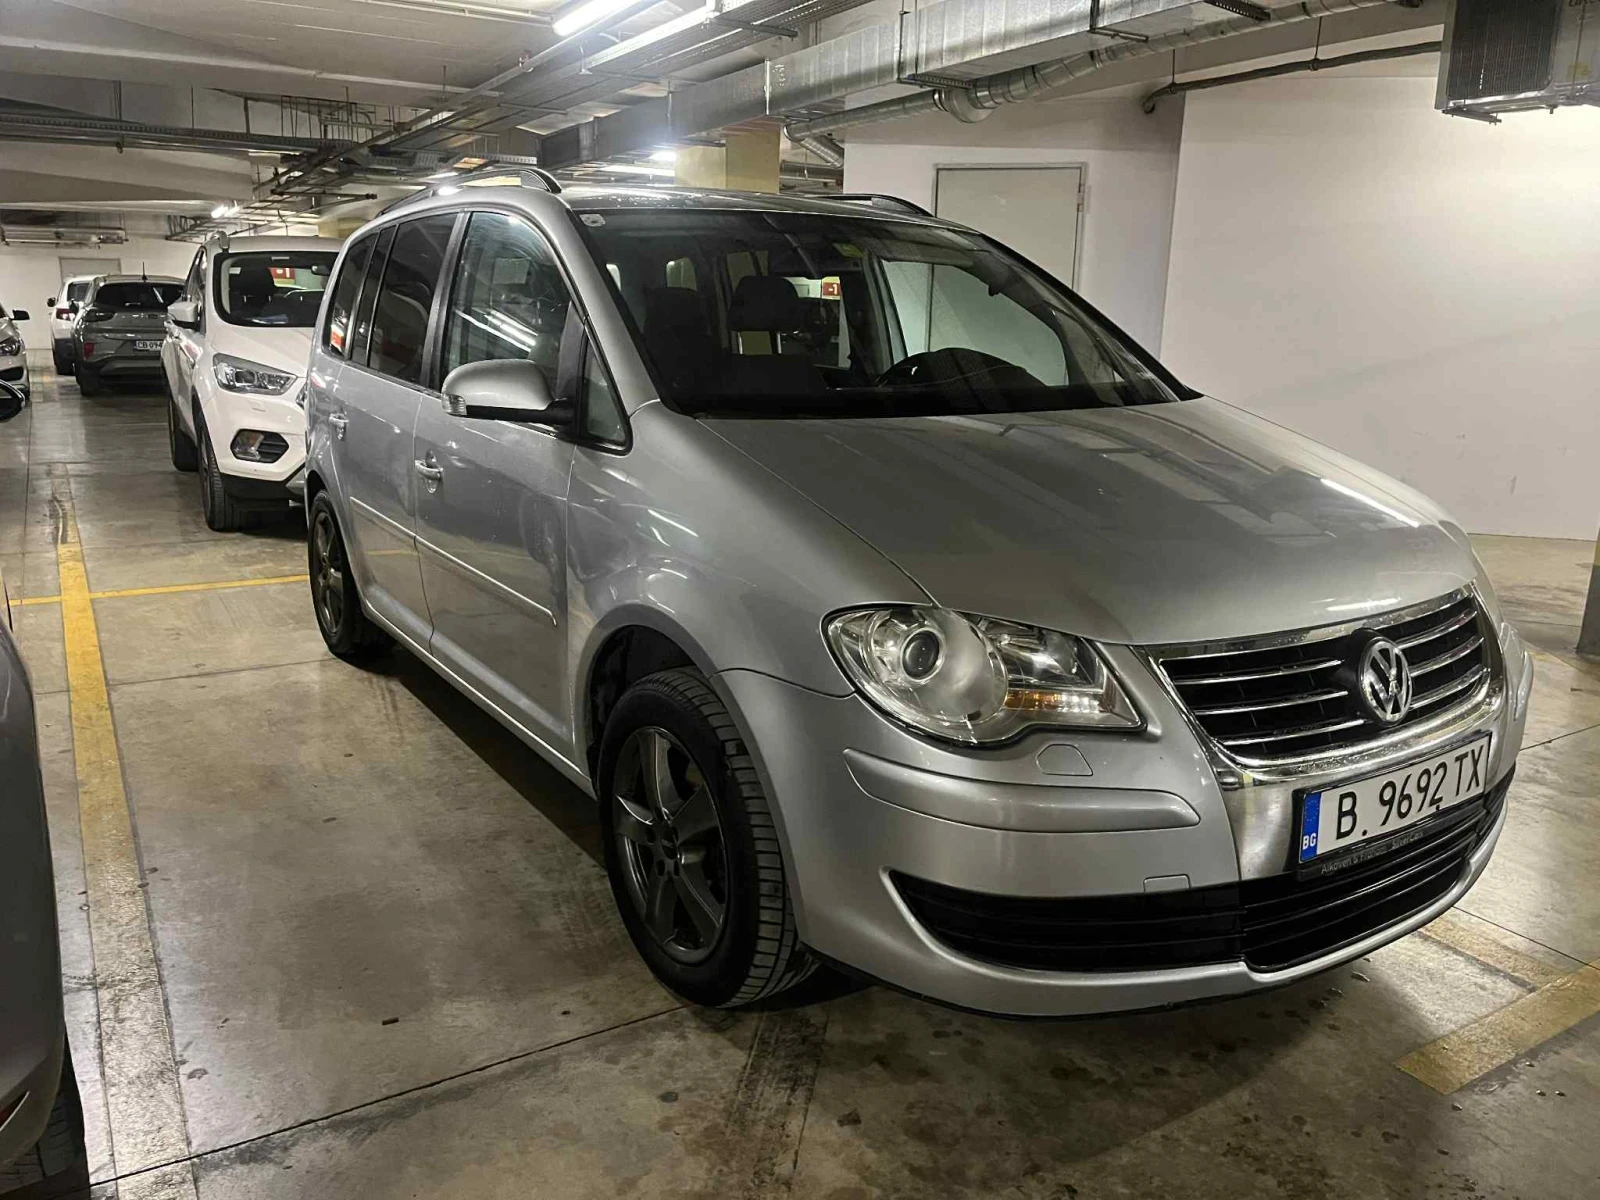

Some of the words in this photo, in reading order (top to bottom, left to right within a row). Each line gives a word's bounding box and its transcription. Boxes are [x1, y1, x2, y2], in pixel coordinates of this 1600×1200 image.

[828, 284, 838, 295] -1
[1363, 642, 1411, 722] VW
[1379, 761, 1448, 827] 9692
[1455, 746, 1484, 797] TX
[1302, 833, 1317, 850] BG
